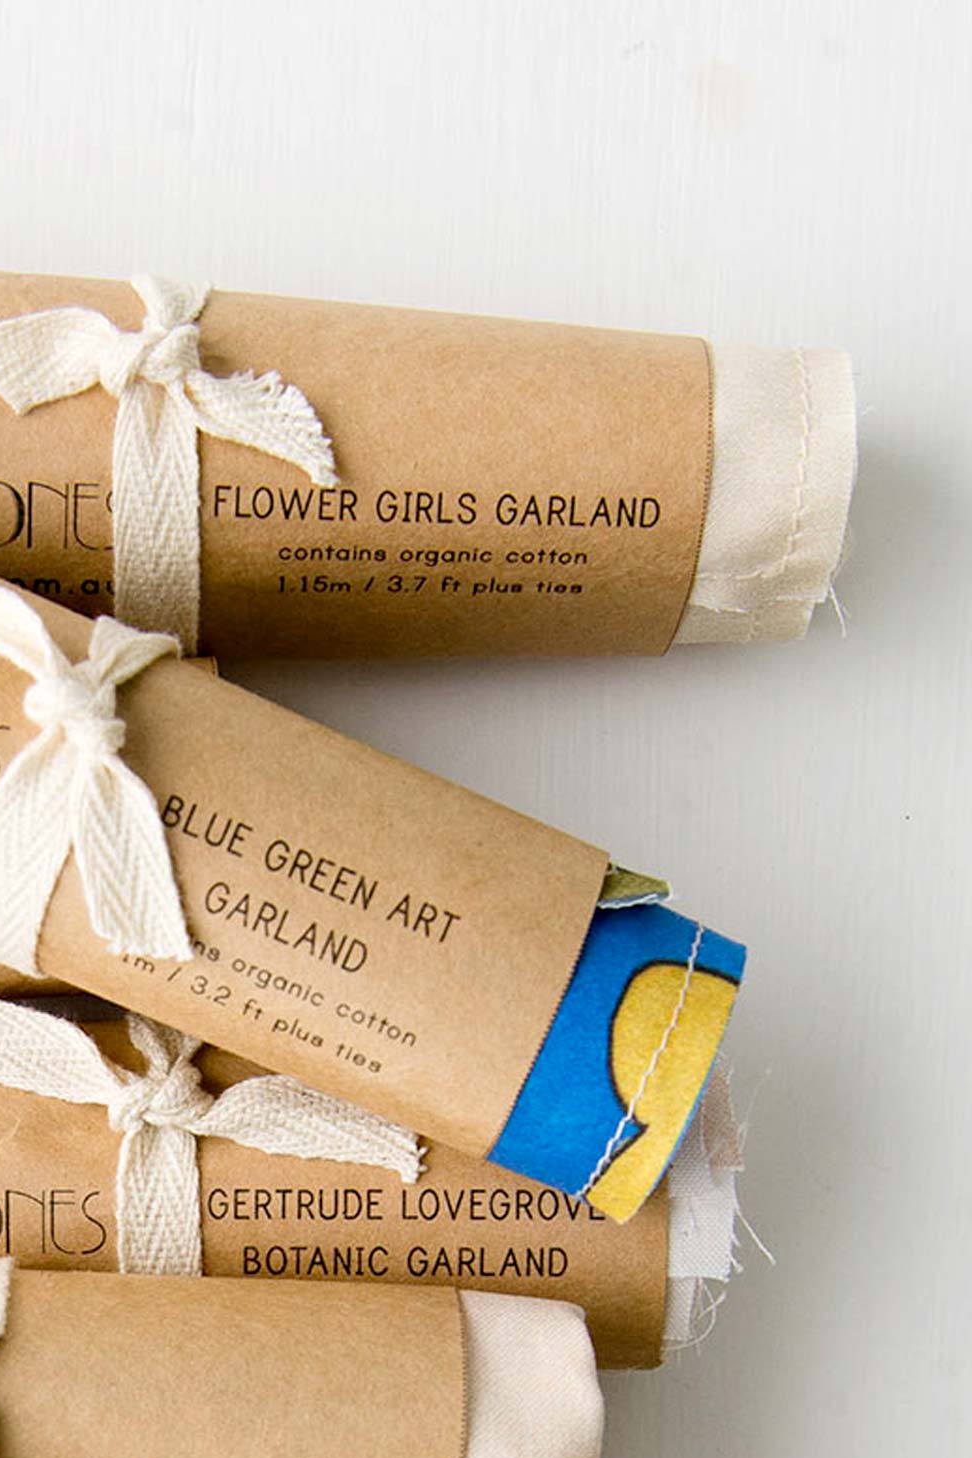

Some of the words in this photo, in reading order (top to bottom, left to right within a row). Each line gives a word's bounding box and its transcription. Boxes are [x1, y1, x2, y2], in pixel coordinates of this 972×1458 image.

[213, 485, 357, 521] FLOWER
[375, 490, 477, 524] GIRLS
[495, 494, 661, 529] GARLAND
[278, 545, 387, 562] contains
[400, 547, 493, 567] organic
[505, 547, 588, 565] cotton
[277, 576, 352, 595] 1.15m
[363, 576, 375, 593] /
[387, 576, 427, 594] 3.7
[441, 577, 461, 593] ft
[472, 578, 523, 597] plus
[536, 580, 582, 595] ties
[161, 794, 255, 858] BLUE
[264, 840, 379, 912] GREEN
[386, 894, 462, 945] ART
[204, 881, 370, 975] GARLAND
[167, 967, 182, 982] /
[190, 975, 232, 1006] 3.2
[242, 1000, 265, 1020] ft
[272, 1018, 324, 1050] plus
[336, 1043, 383, 1075] ties
[231, 957, 325, 1009] organic
[335, 1001, 419, 1048] cotton
[207, 1188, 384, 1221] GERTRUDE
[243, 1246, 389, 1277] BOTANIC
[407, 1247, 569, 1278] GARLAND
